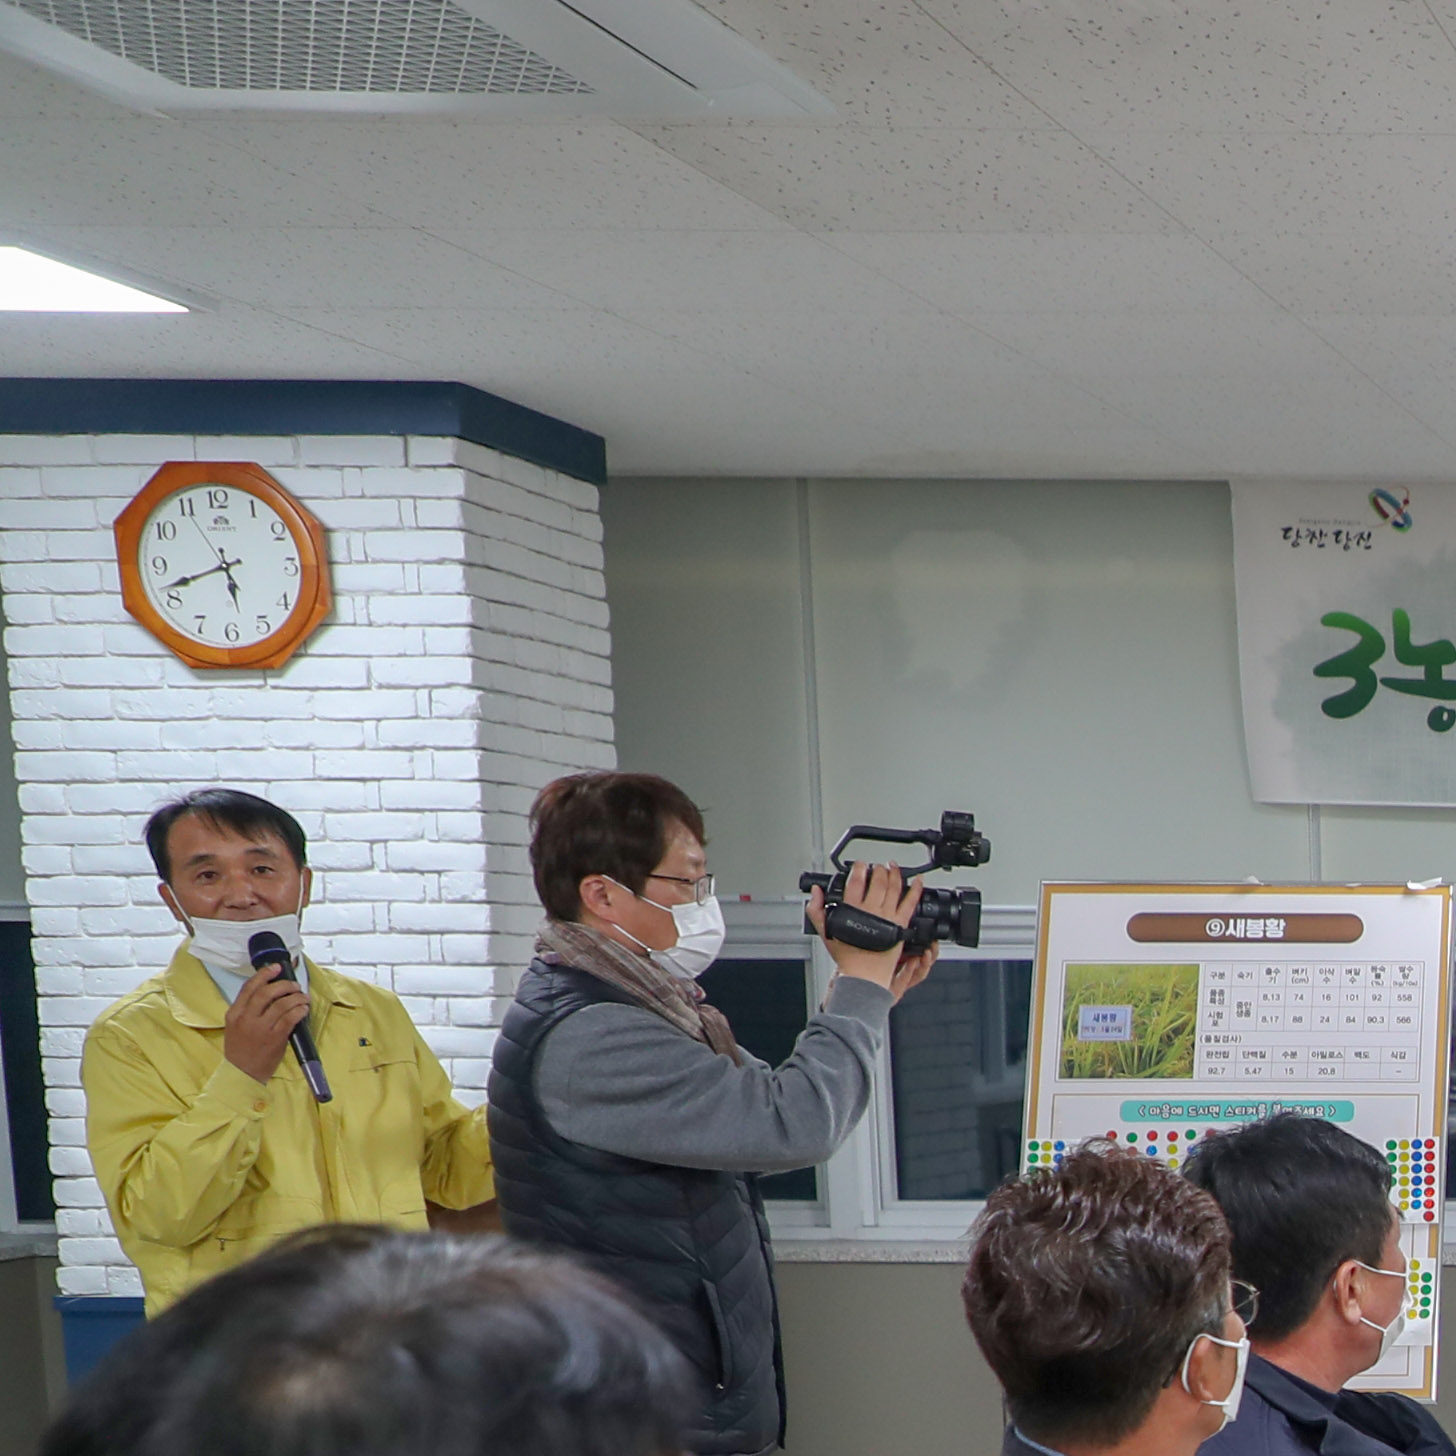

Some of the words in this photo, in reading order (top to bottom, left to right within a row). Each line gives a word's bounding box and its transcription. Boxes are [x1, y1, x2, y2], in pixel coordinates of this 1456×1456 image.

[179, 498, 196, 516] 11
[206, 489, 229, 509] 12
[249, 499, 257, 518] 1
[156, 521, 176, 541] 10
[270, 521, 286, 541] 2
[152, 556, 167, 576] 9
[284, 557, 298, 576] 3
[166, 590, 182, 609] 8
[276, 592, 291, 611] 4
[194, 616, 206, 634] 7
[225, 623, 239, 642] 6
[256, 616, 271, 634] 5
[846, 919, 878, 936] SONY
[1263, 993, 1280, 1001] 8.13
[1150, 1105, 1183, 1119] 마음에
[1188, 1105, 1220, 1117] 드시면
[1225, 1105, 1266, 1119] 스티커를
